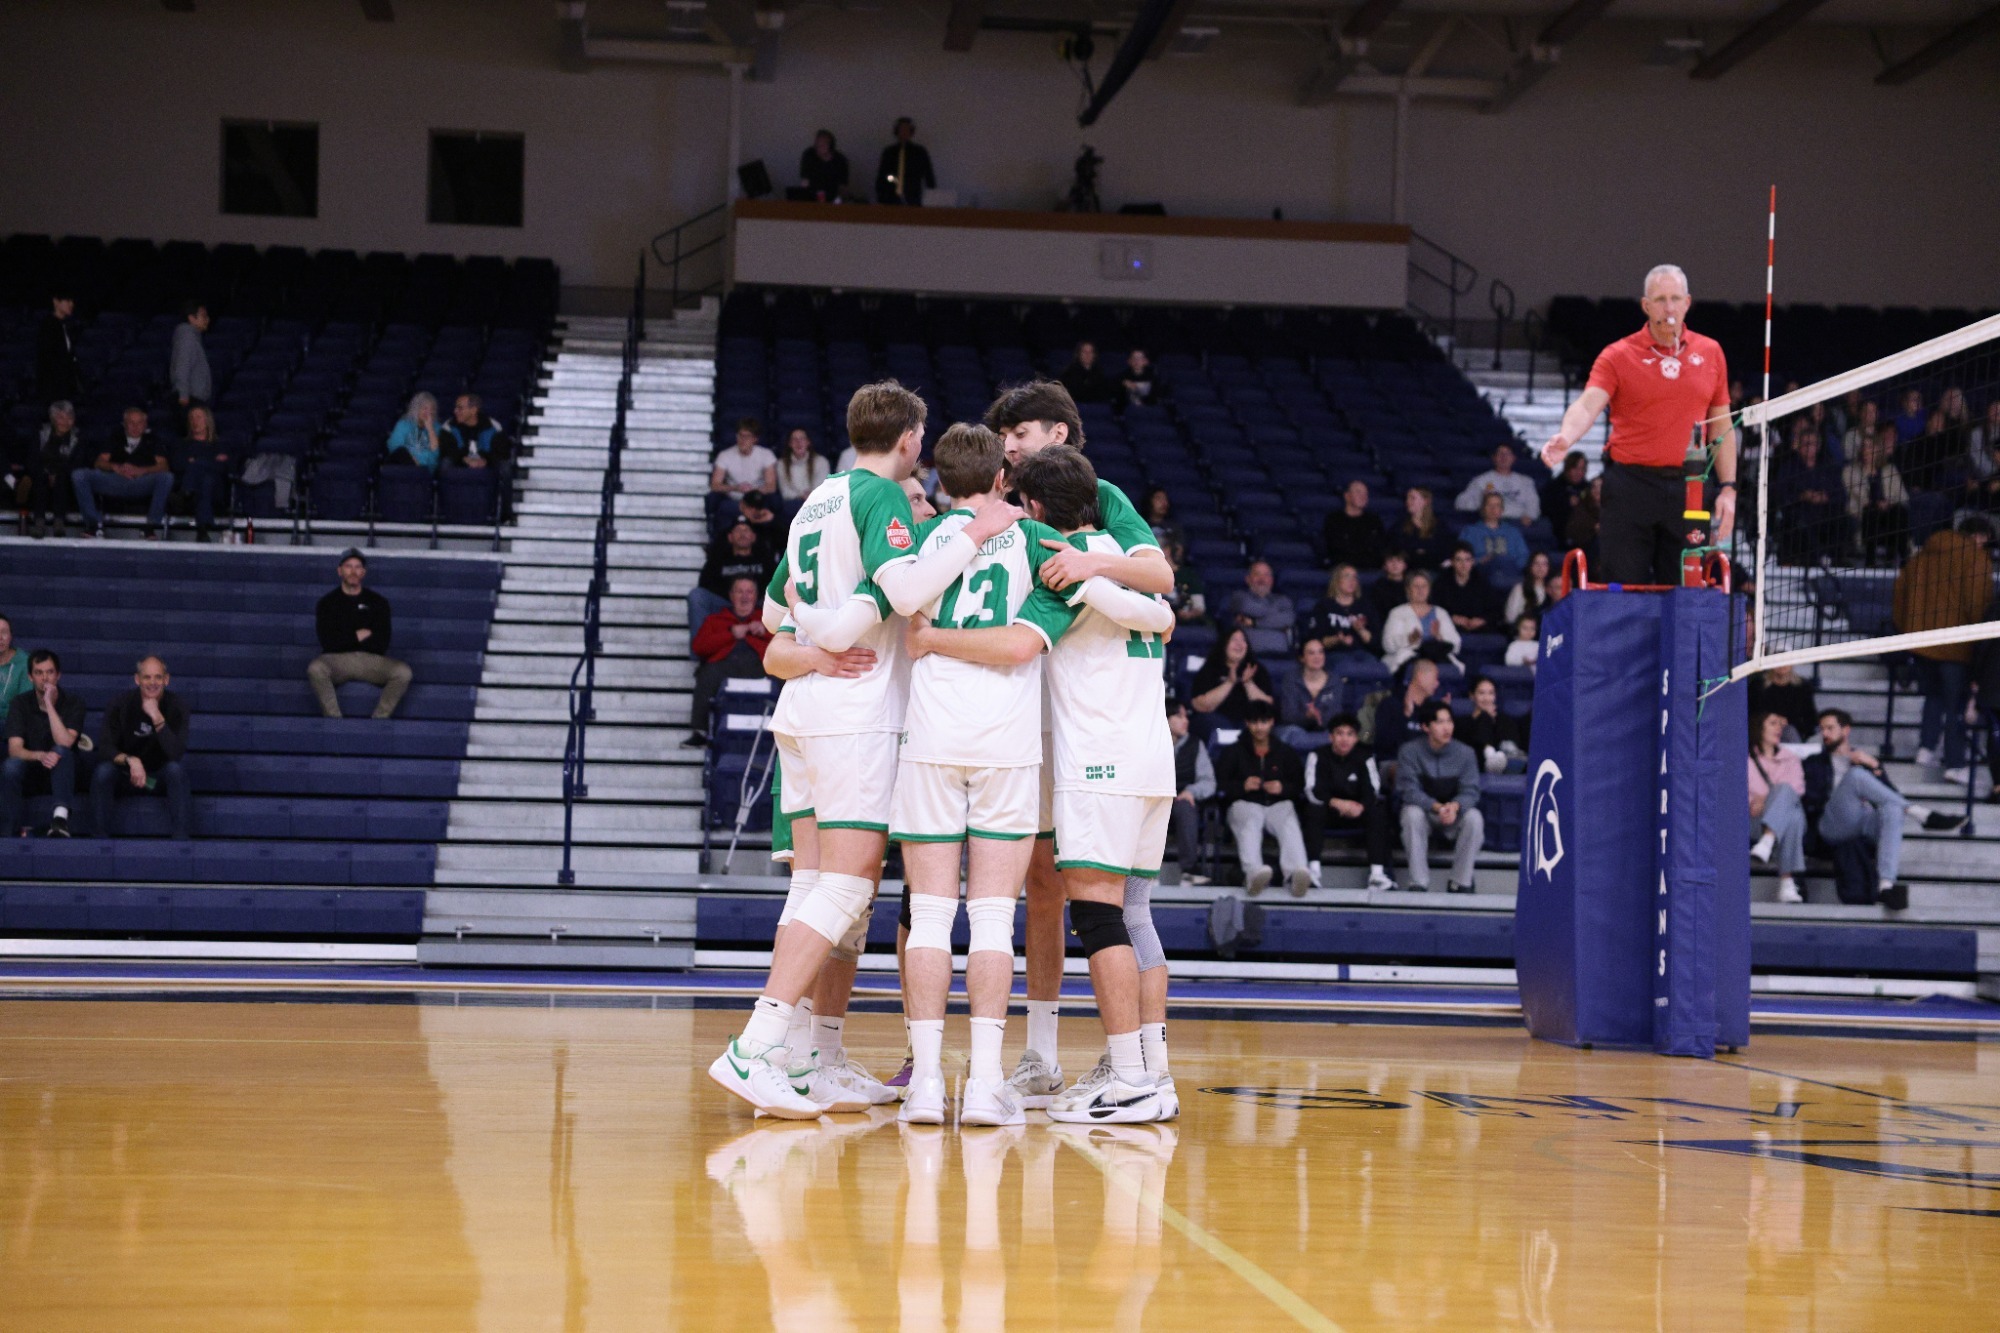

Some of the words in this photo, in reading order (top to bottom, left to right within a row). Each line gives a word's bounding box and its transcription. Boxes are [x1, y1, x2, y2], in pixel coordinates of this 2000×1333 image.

[796, 529, 822, 605] 5
[890, 536, 910, 546] WEST
[931, 562, 1010, 629] 13
[1328, 613, 1363, 628] TW
[1657, 668, 1669, 976] SPARTANS
